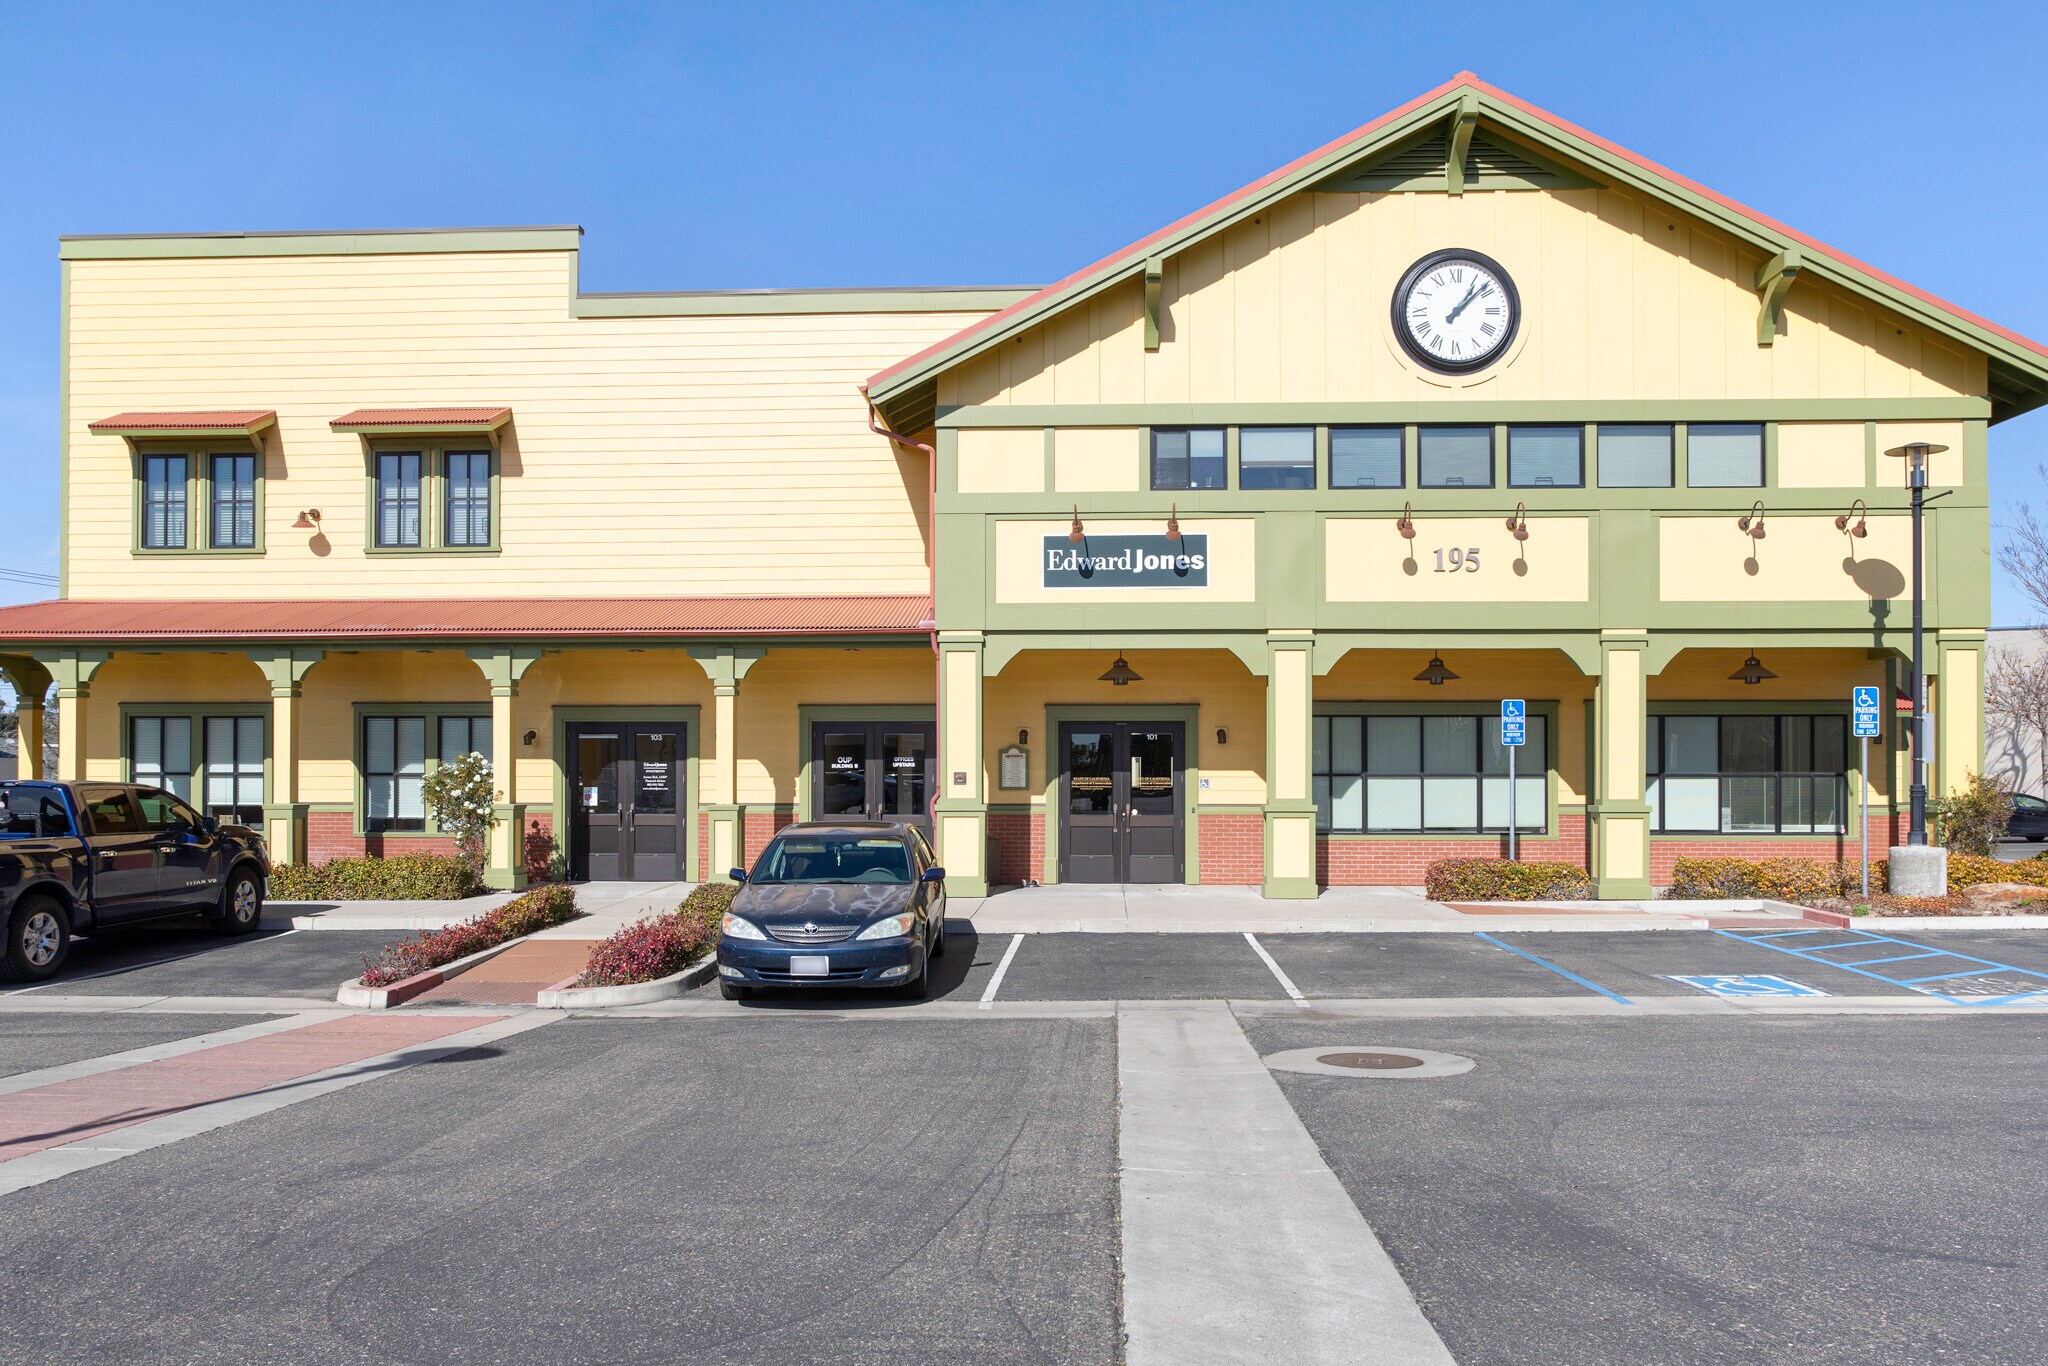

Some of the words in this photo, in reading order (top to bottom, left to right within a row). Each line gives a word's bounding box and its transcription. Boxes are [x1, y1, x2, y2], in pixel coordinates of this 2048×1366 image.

[1433, 547, 1480, 573] 195
[1855, 706, 1878, 714] PARKING
[1859, 714, 1873, 722] ONLY
